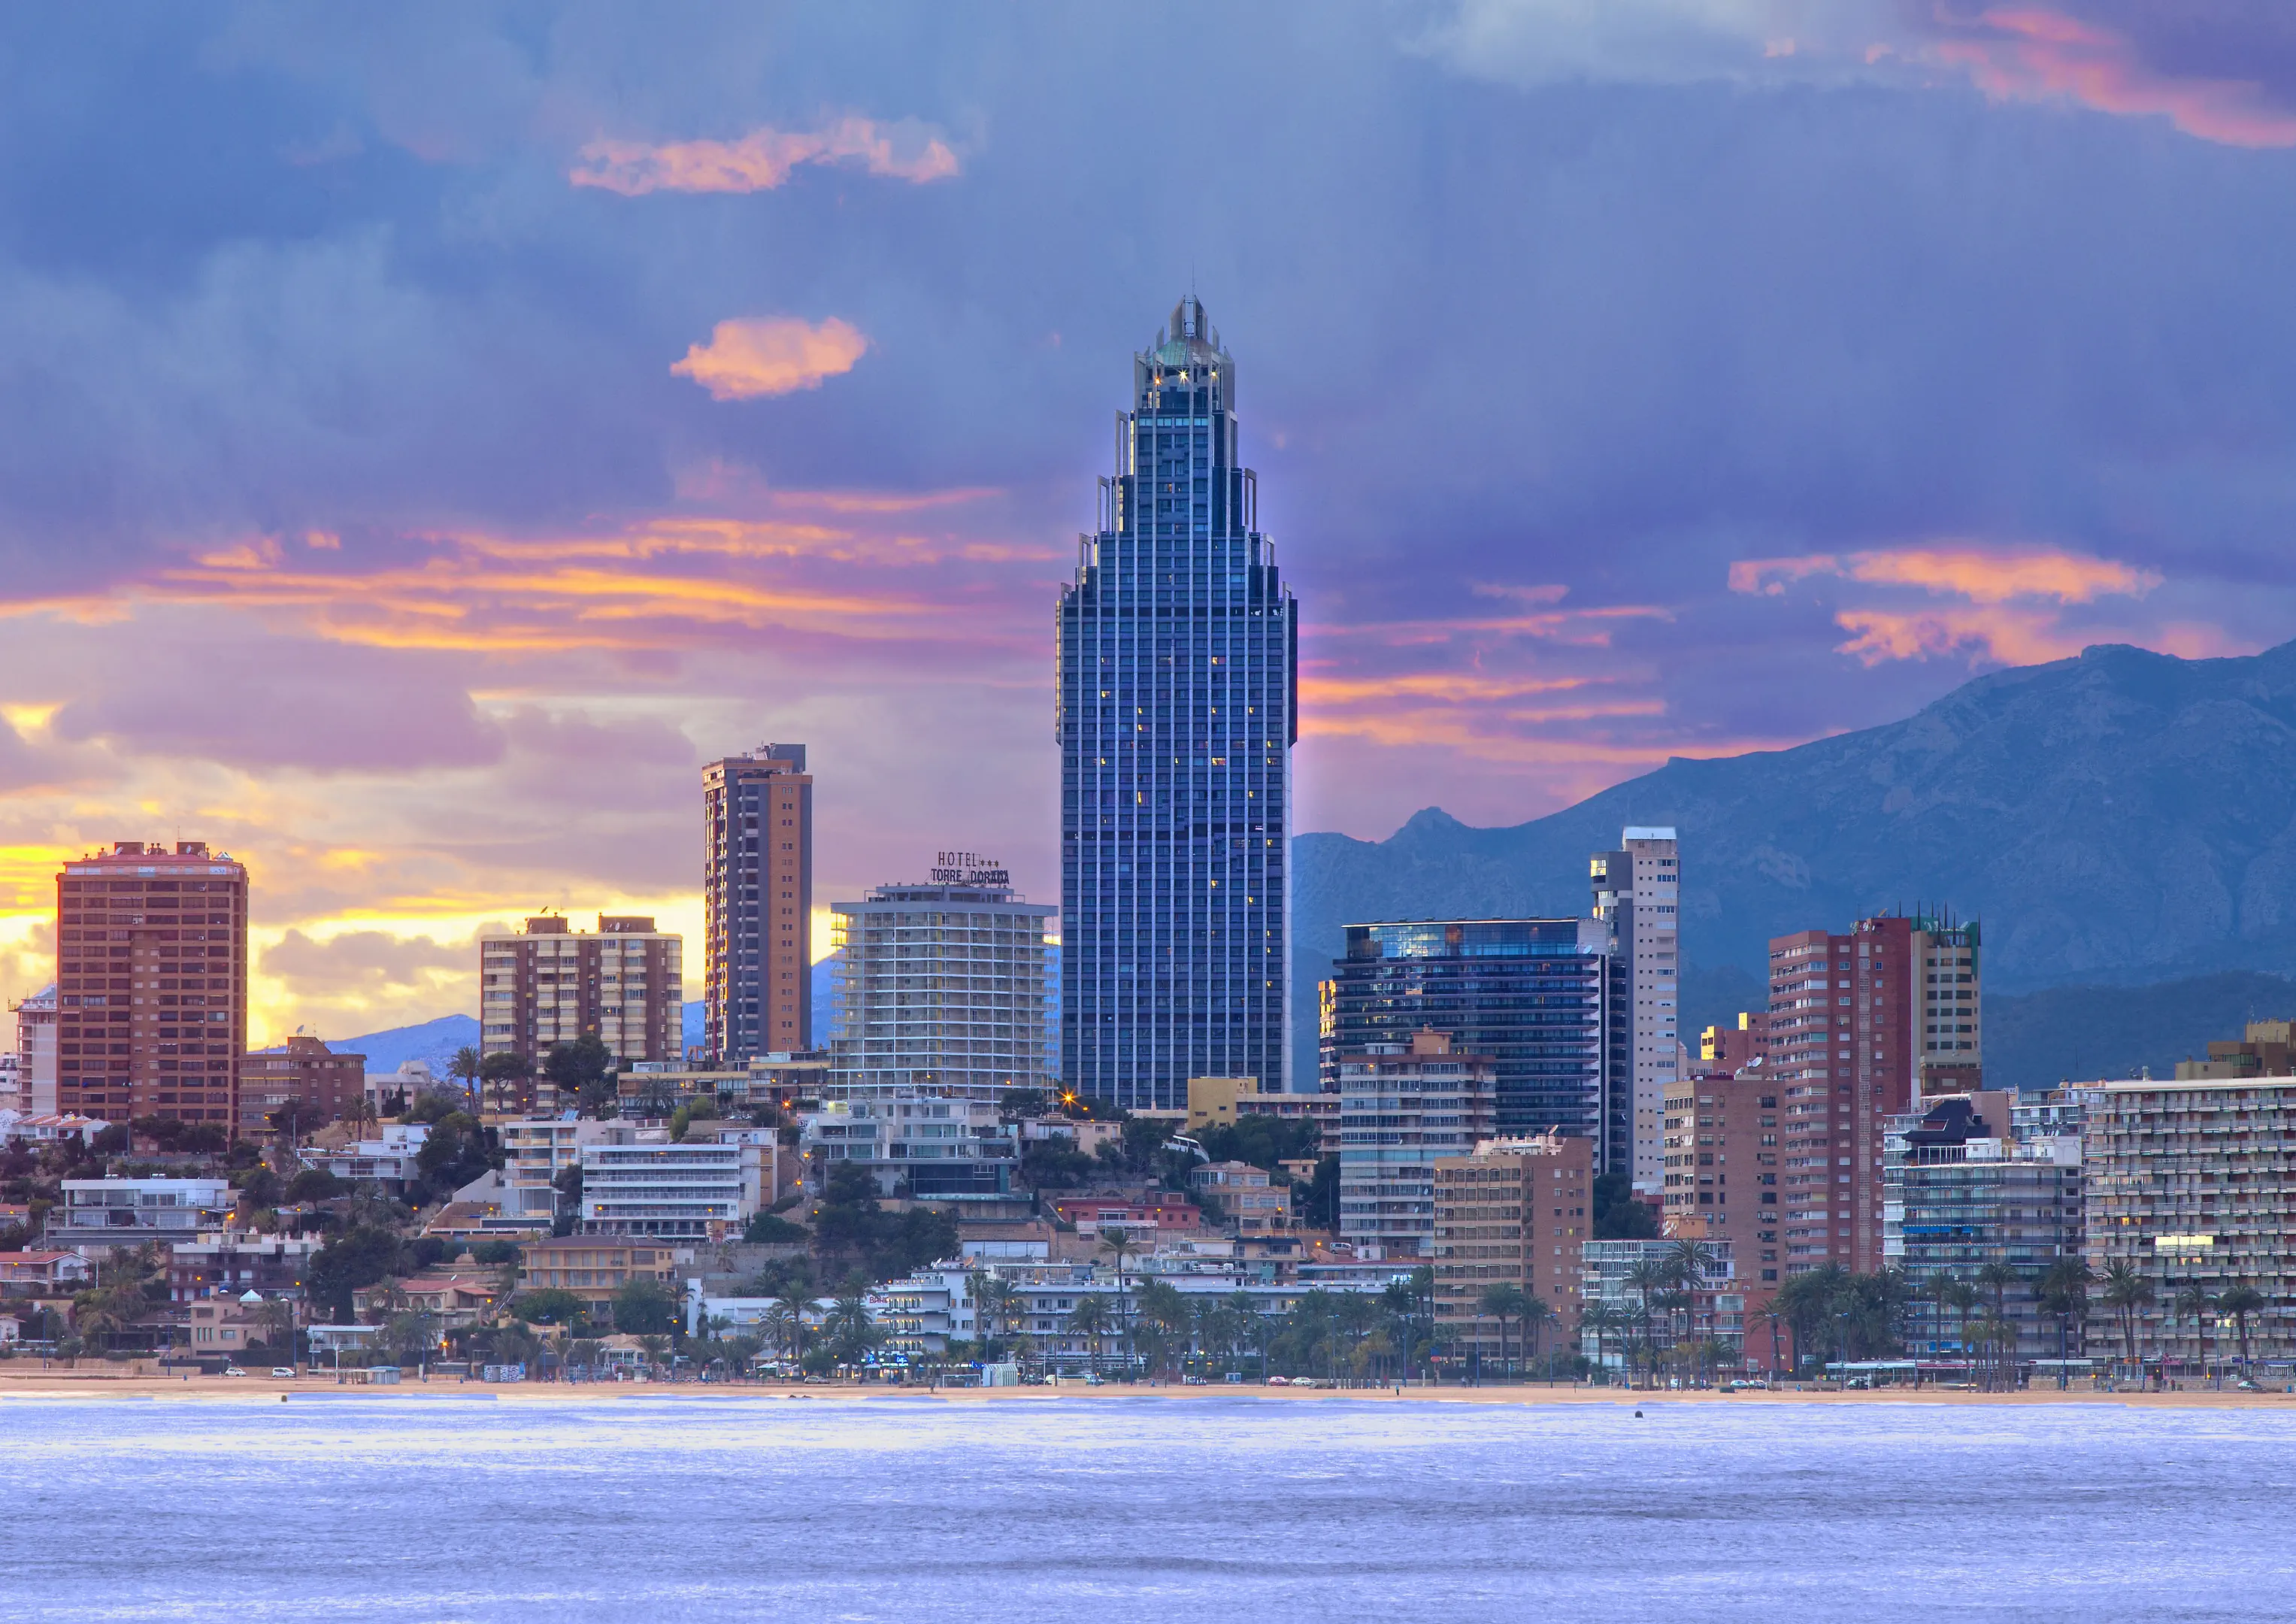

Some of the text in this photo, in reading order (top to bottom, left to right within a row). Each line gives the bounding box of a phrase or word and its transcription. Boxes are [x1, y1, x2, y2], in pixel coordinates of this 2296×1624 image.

[938, 852, 977, 866] HOTEL
[931, 868, 1010, 884] TORRE DORADA
